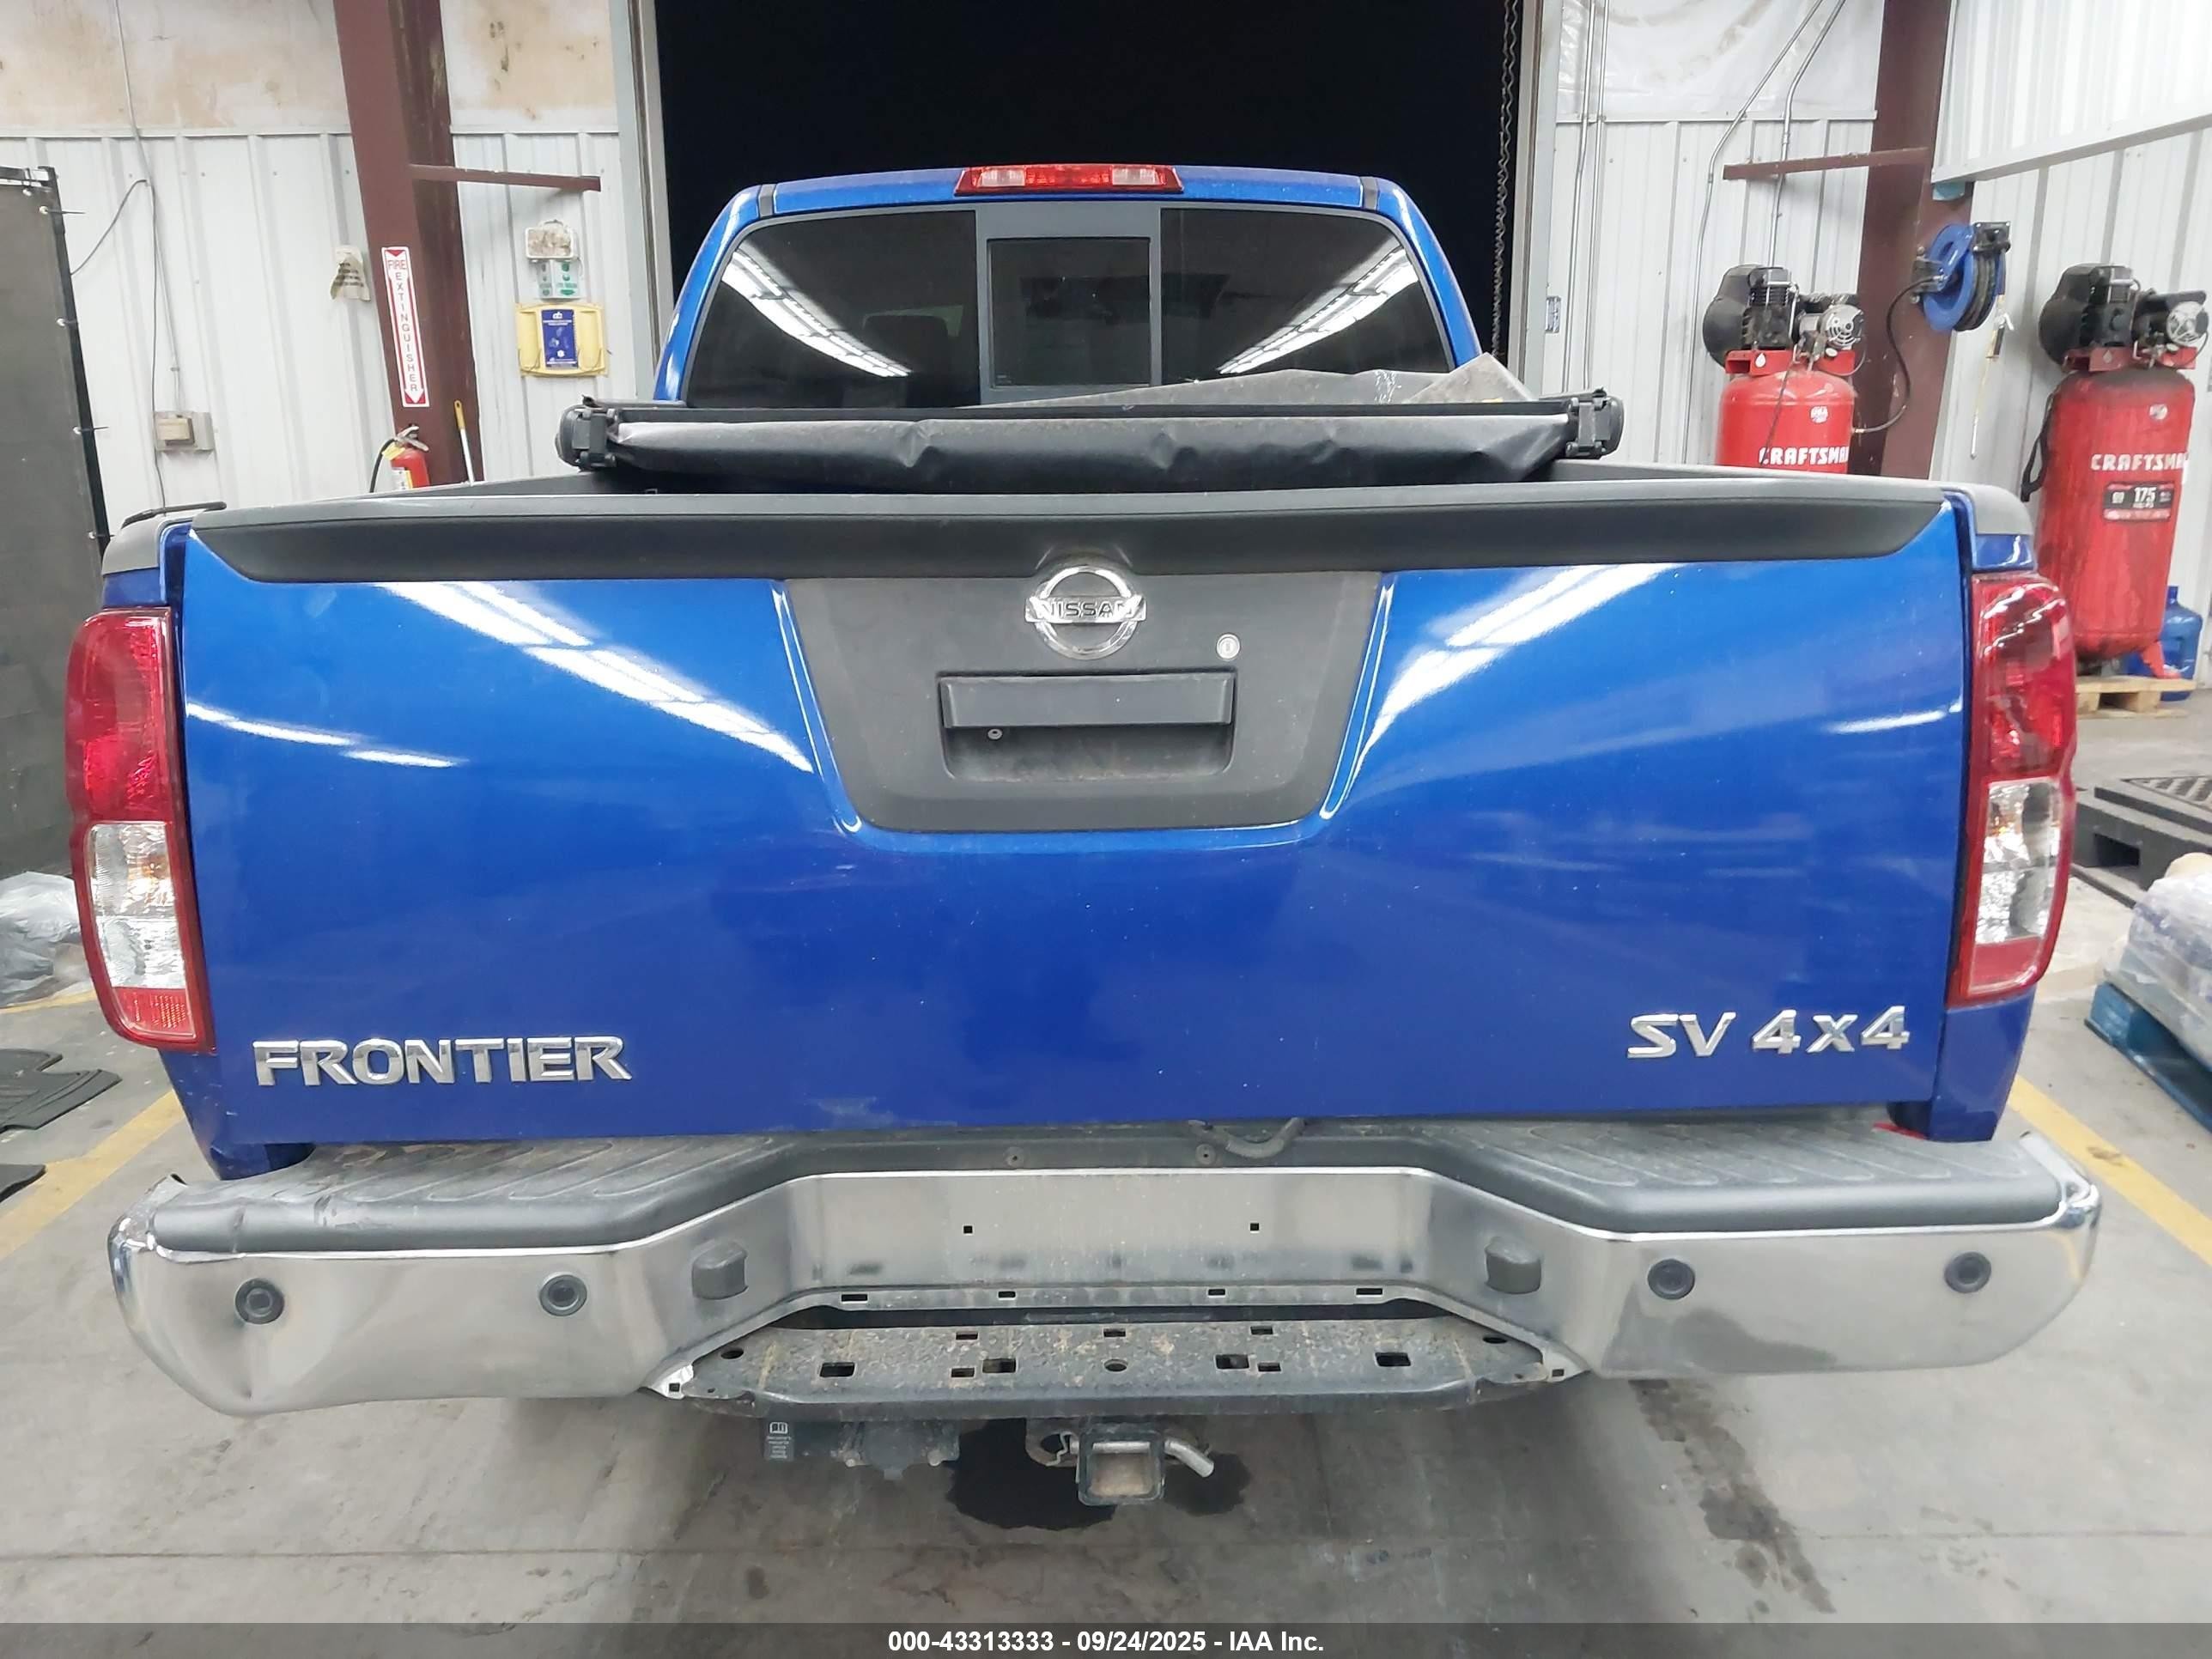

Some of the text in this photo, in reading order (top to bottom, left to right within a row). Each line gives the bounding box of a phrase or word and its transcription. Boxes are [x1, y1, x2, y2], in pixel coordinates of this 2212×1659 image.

[387, 259, 407, 270] FIRE
[395, 271, 417, 392] EXTINGUISHER
[1758, 447, 1850, 465] CRAFTSMA
[2134, 486, 2157, 502] 175
[1038, 599, 1133, 618] NISSAN
[1626, 1006, 1911, 1059] SV 4x4
[252, 1036, 633, 1086] FRONTIER
